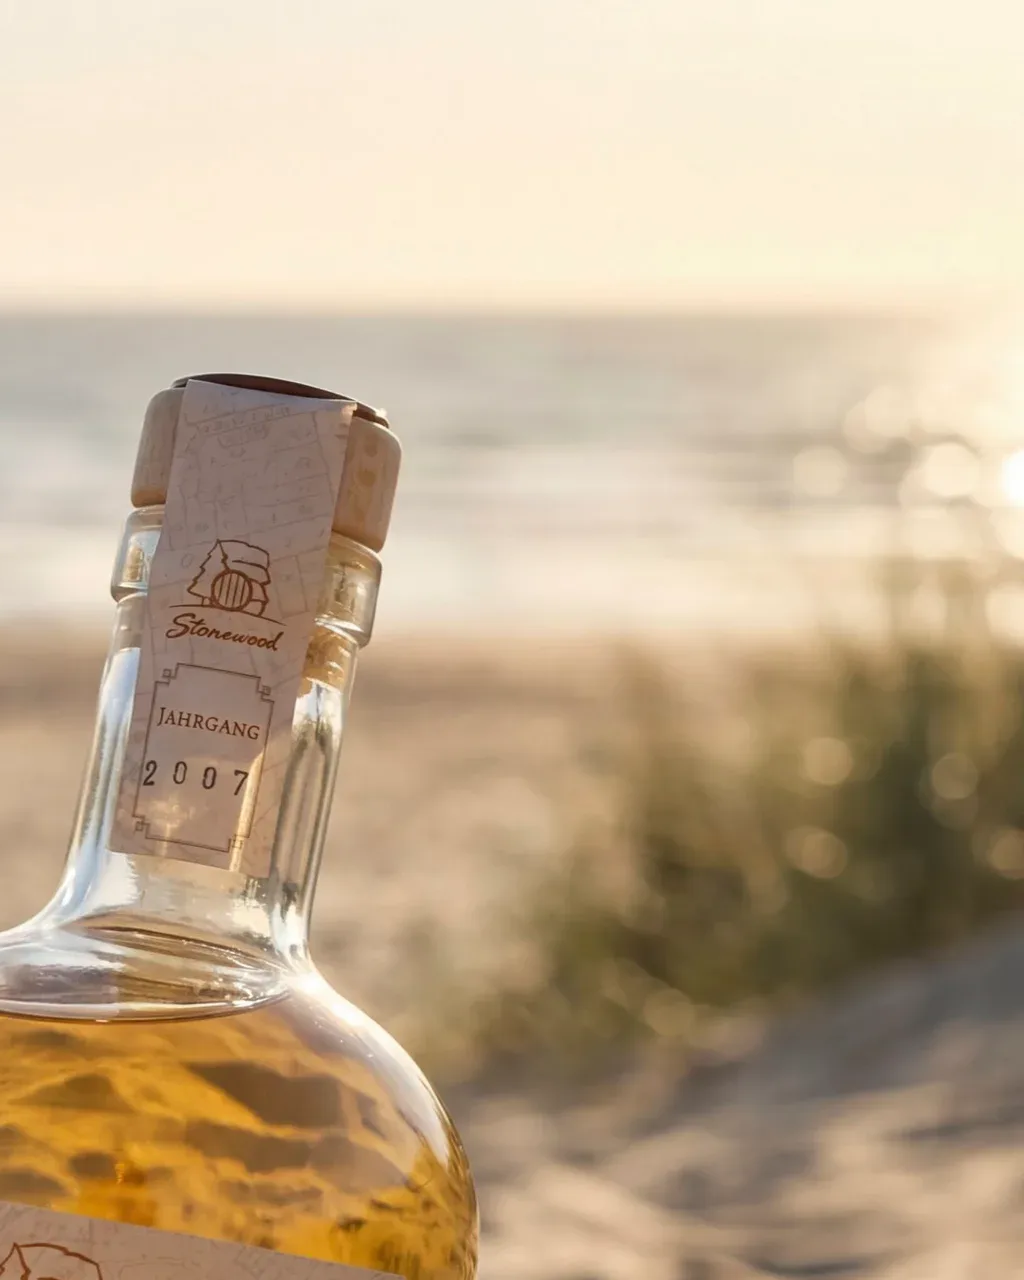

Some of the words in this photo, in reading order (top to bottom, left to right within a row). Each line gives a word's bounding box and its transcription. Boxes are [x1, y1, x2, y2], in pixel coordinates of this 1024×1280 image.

[165, 612, 285, 652] Stonewood
[156, 706, 261, 741] JAHRGANG
[142, 759, 249, 797] 2007
